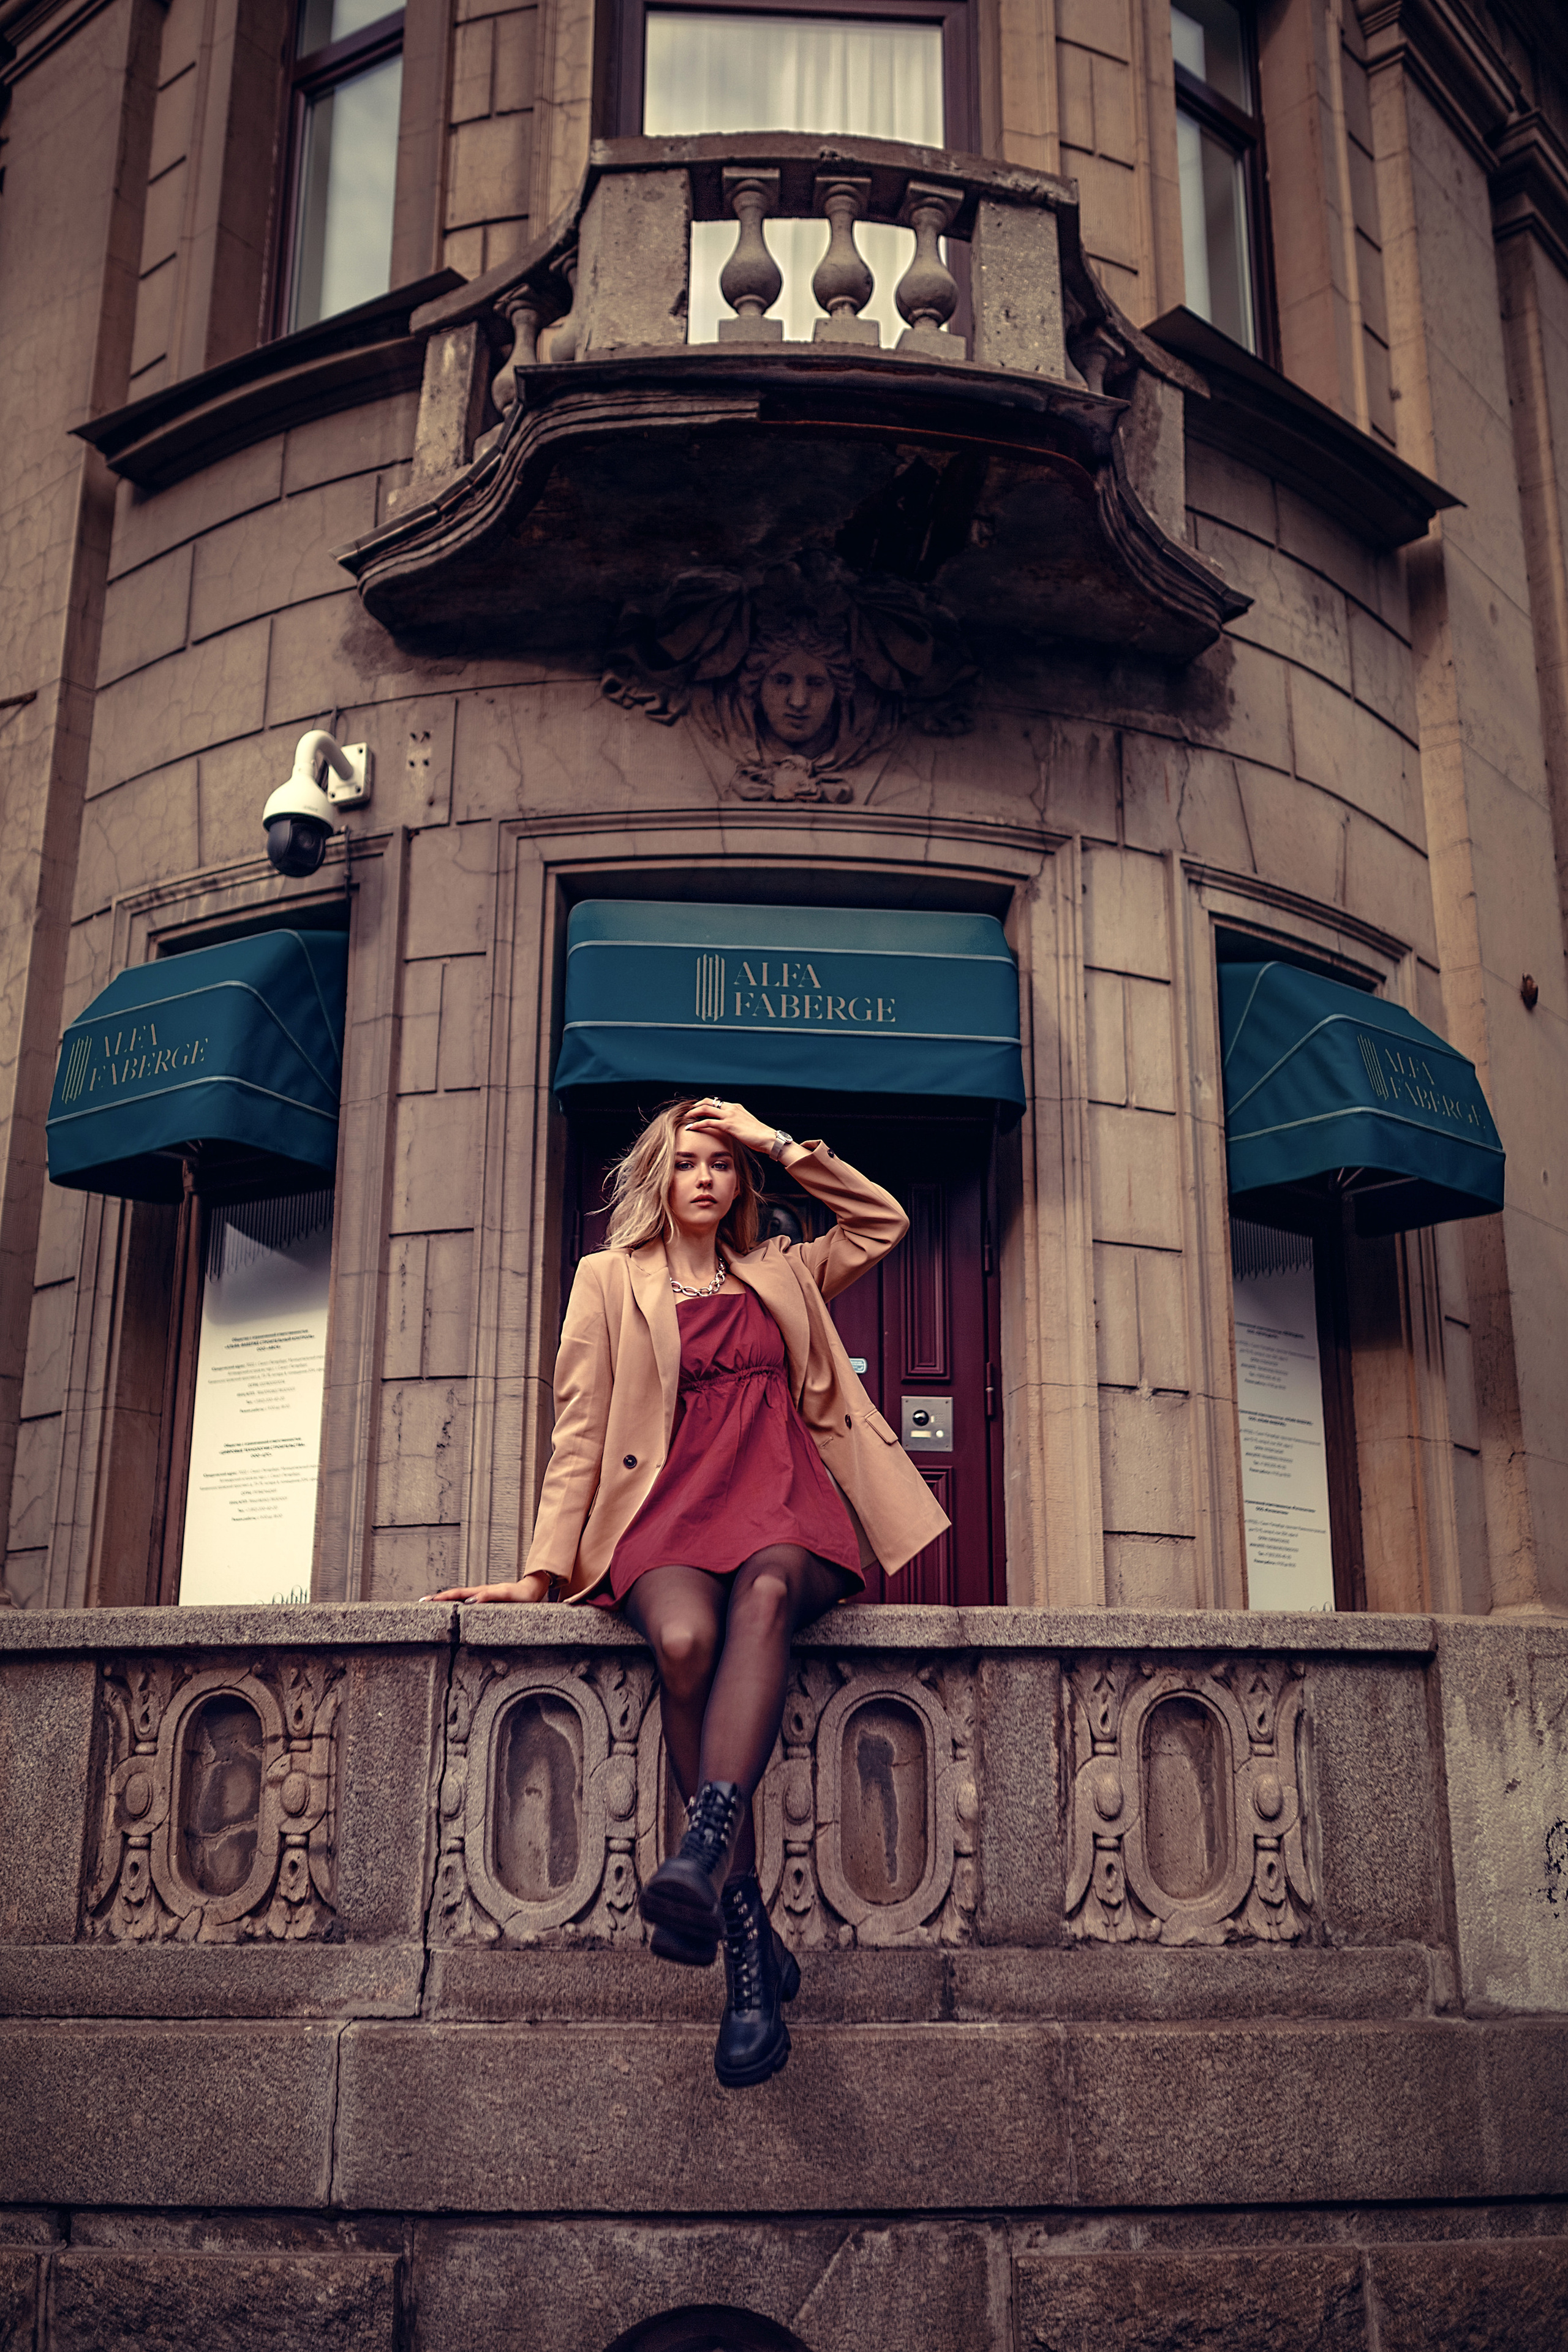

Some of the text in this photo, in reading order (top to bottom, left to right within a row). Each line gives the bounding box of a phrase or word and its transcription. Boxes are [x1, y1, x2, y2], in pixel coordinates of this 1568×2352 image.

[734, 962, 821, 989] ALFA
[735, 992, 895, 1022] FABERGE
[94, 1023, 157, 1061] ALFA
[89, 1038, 208, 1091] FABERGE
[1385, 1049, 1434, 1085] ALFA
[1390, 1077, 1486, 1129] FABERGE
